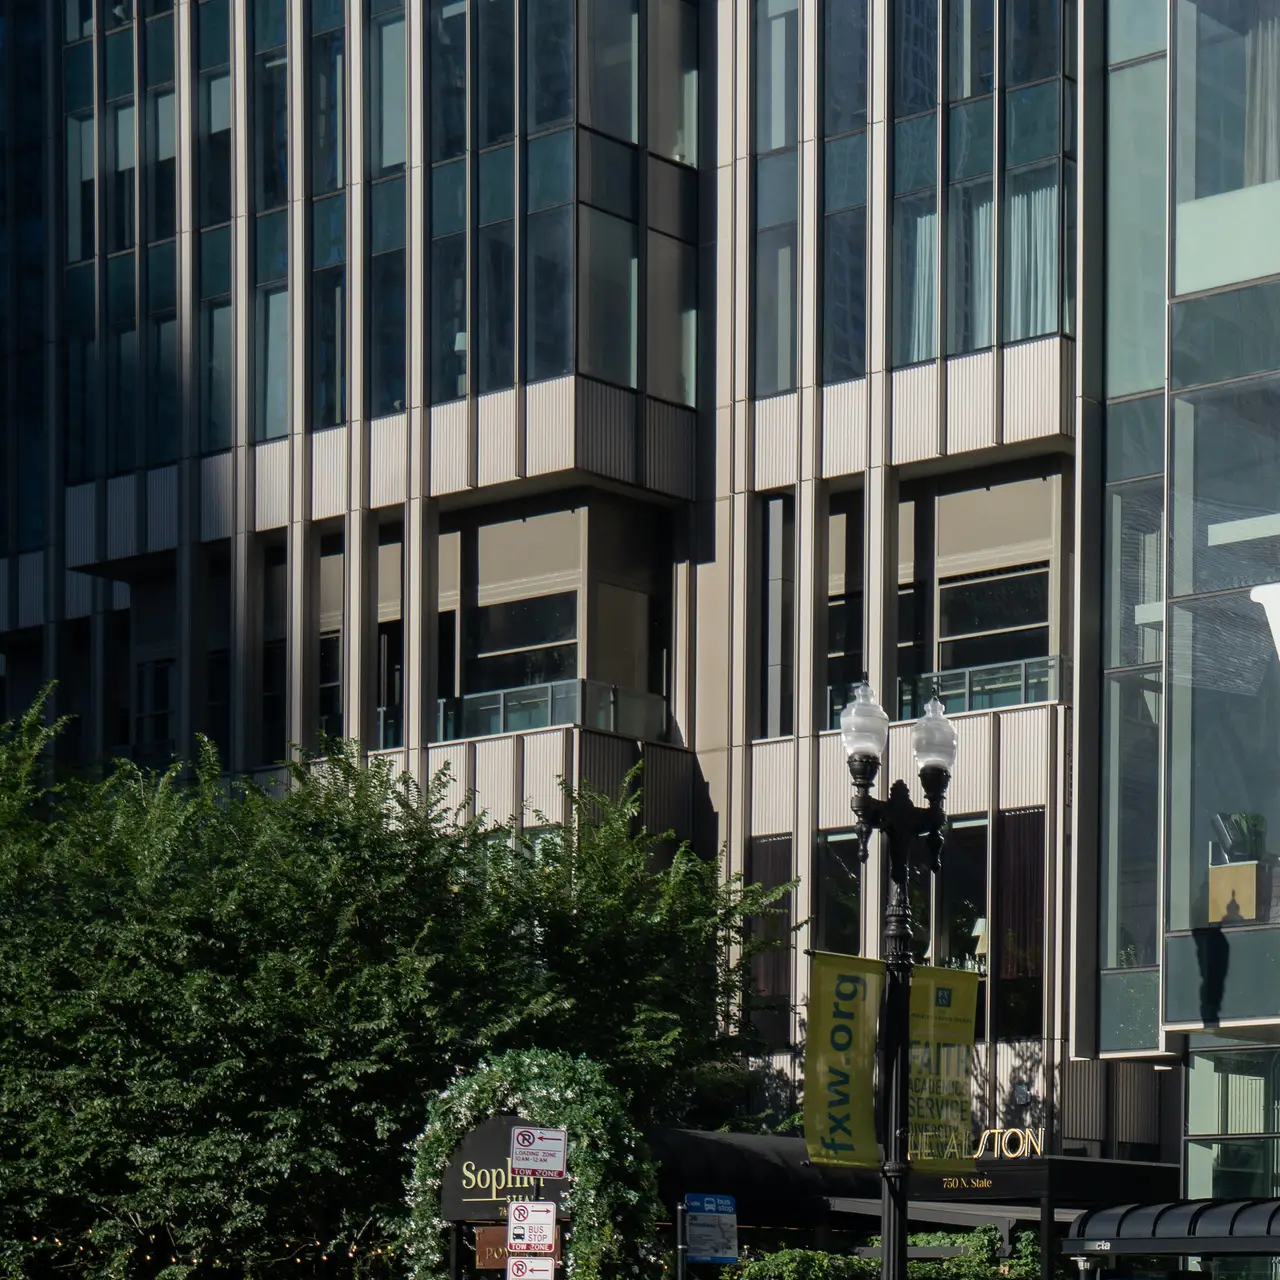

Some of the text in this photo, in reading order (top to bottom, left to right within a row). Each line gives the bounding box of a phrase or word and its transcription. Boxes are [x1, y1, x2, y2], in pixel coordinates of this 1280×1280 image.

[908, 1040, 971, 1076] FAITH
[820, 973, 867, 1155] fxw.org
[908, 1097, 968, 1121] SERVICE
[514, 1168, 560, 1178] TOW ZONE
[943, 1178, 993, 1189] 750 N. State
[717, 1205, 734, 1213] stop
[528, 1234, 548, 1242] STOP
[530, 1243, 550, 1251] ZONE
